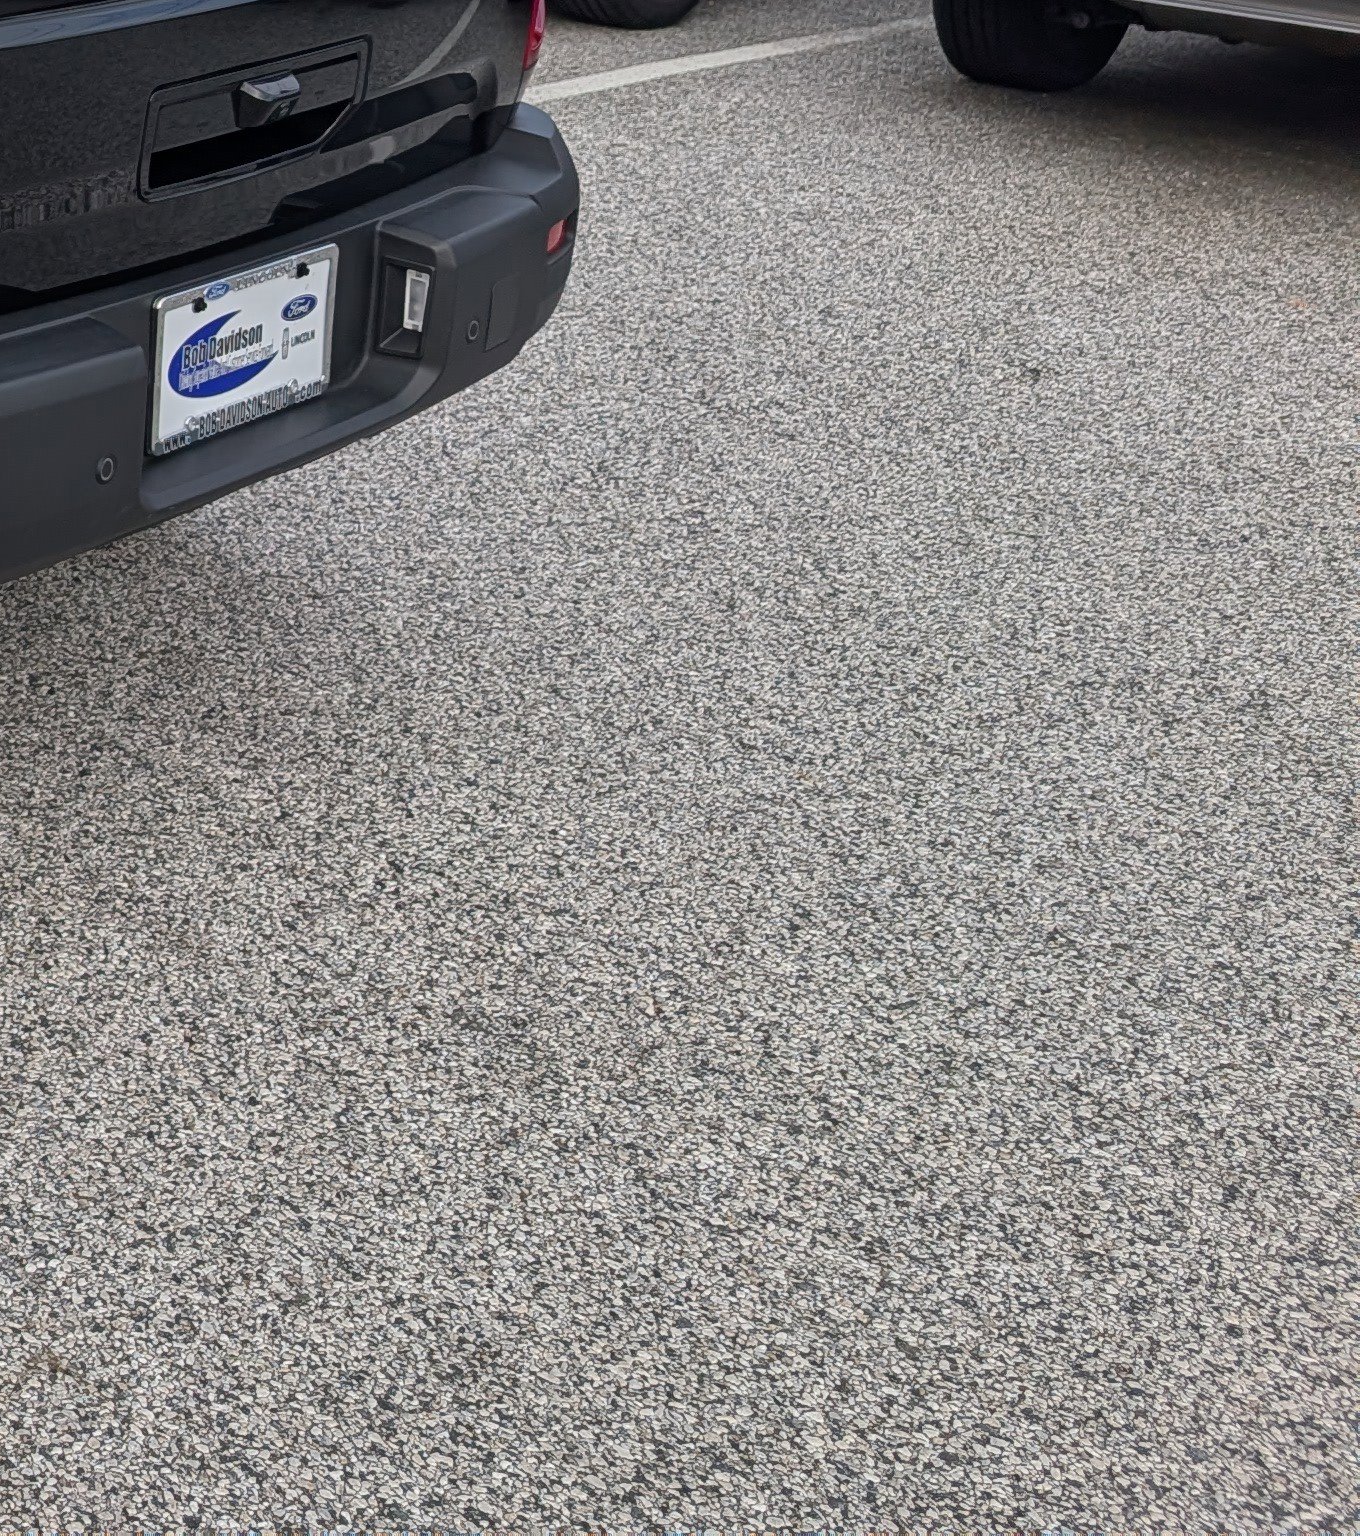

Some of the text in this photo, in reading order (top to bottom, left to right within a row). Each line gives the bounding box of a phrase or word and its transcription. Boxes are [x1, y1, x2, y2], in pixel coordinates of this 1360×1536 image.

[287, 298, 311, 317] Ford
[183, 341, 207, 369] Bob
[209, 323, 263, 359] Davidson
[290, 329, 315, 348] LINCOLN
[198, 412, 217, 440] BOB
[219, 394, 262, 433] DAVIDSON
[264, 384, 289, 415] AUTO
